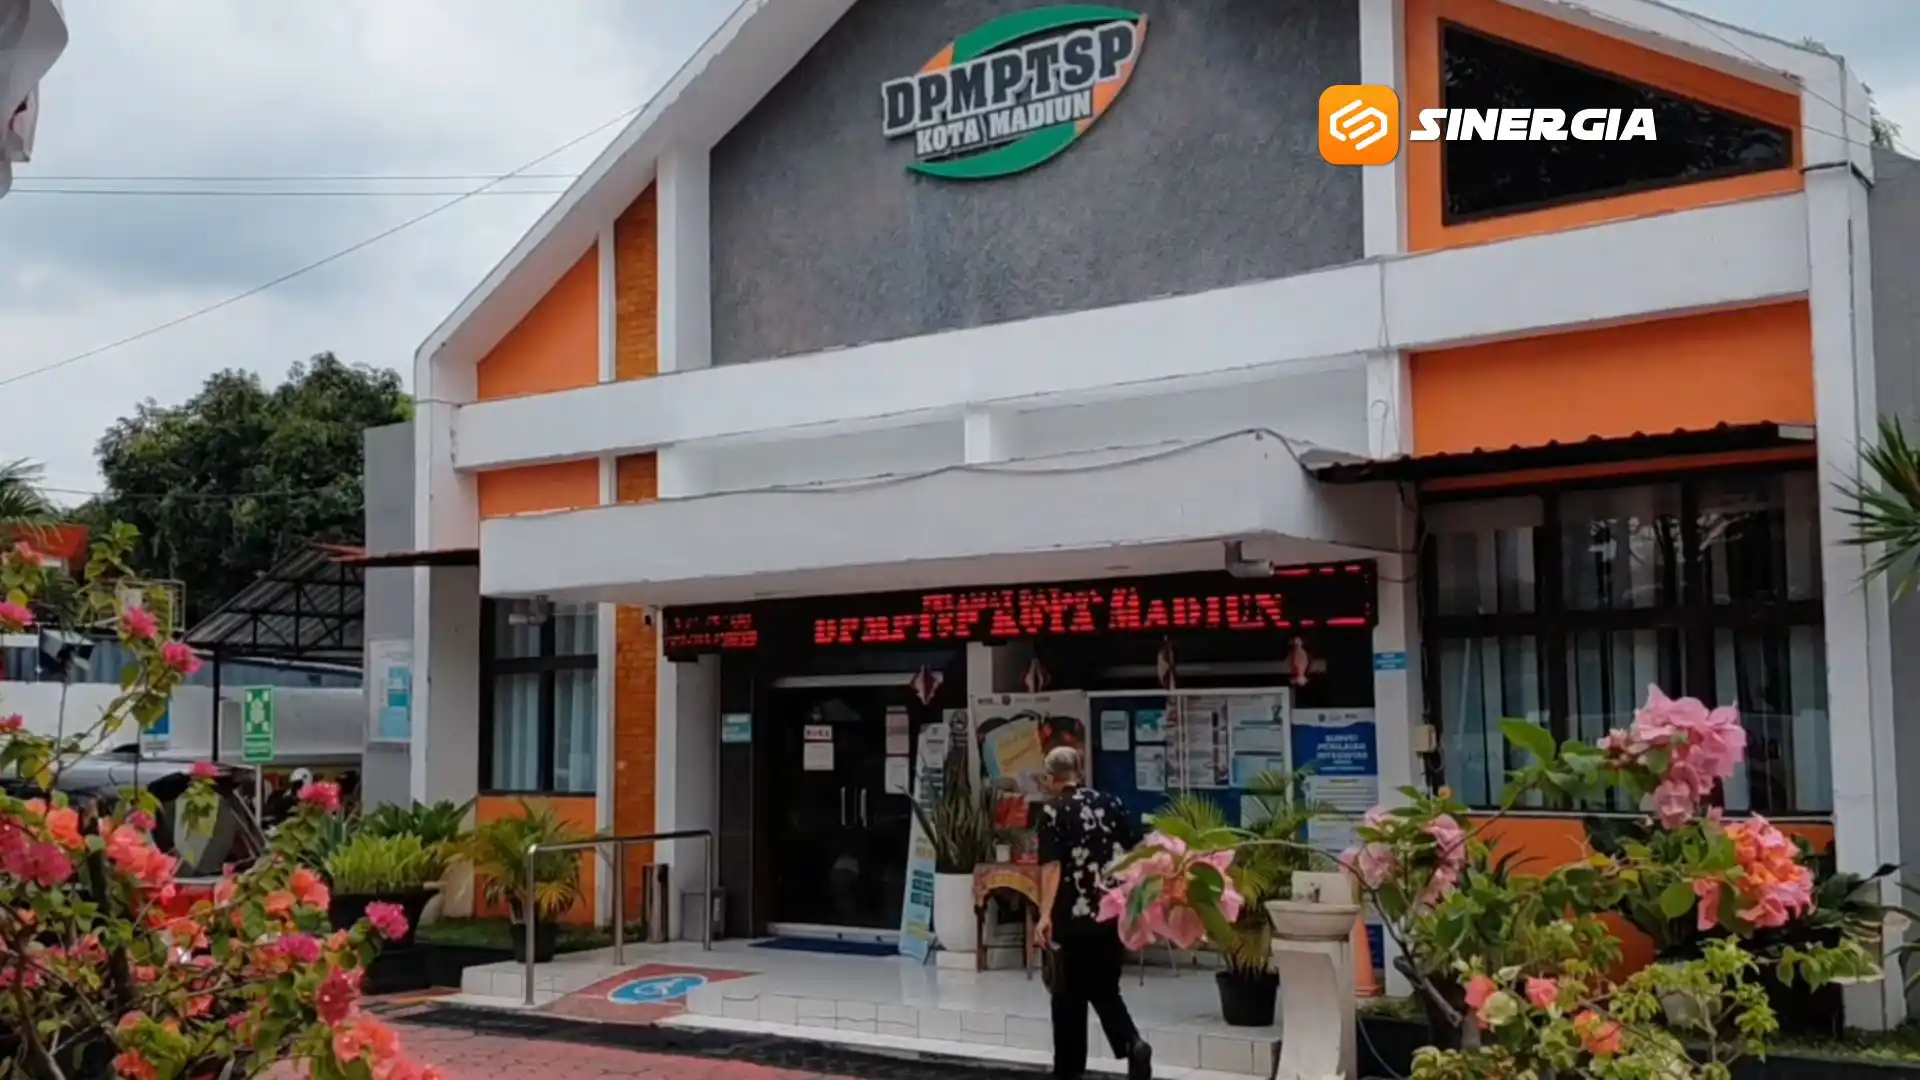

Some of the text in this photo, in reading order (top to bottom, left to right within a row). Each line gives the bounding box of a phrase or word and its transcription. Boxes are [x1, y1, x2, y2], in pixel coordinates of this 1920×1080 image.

[883, 23, 1136, 134] DPMPTSP
[916, 90, 1092, 155] KOTA MADIUN
